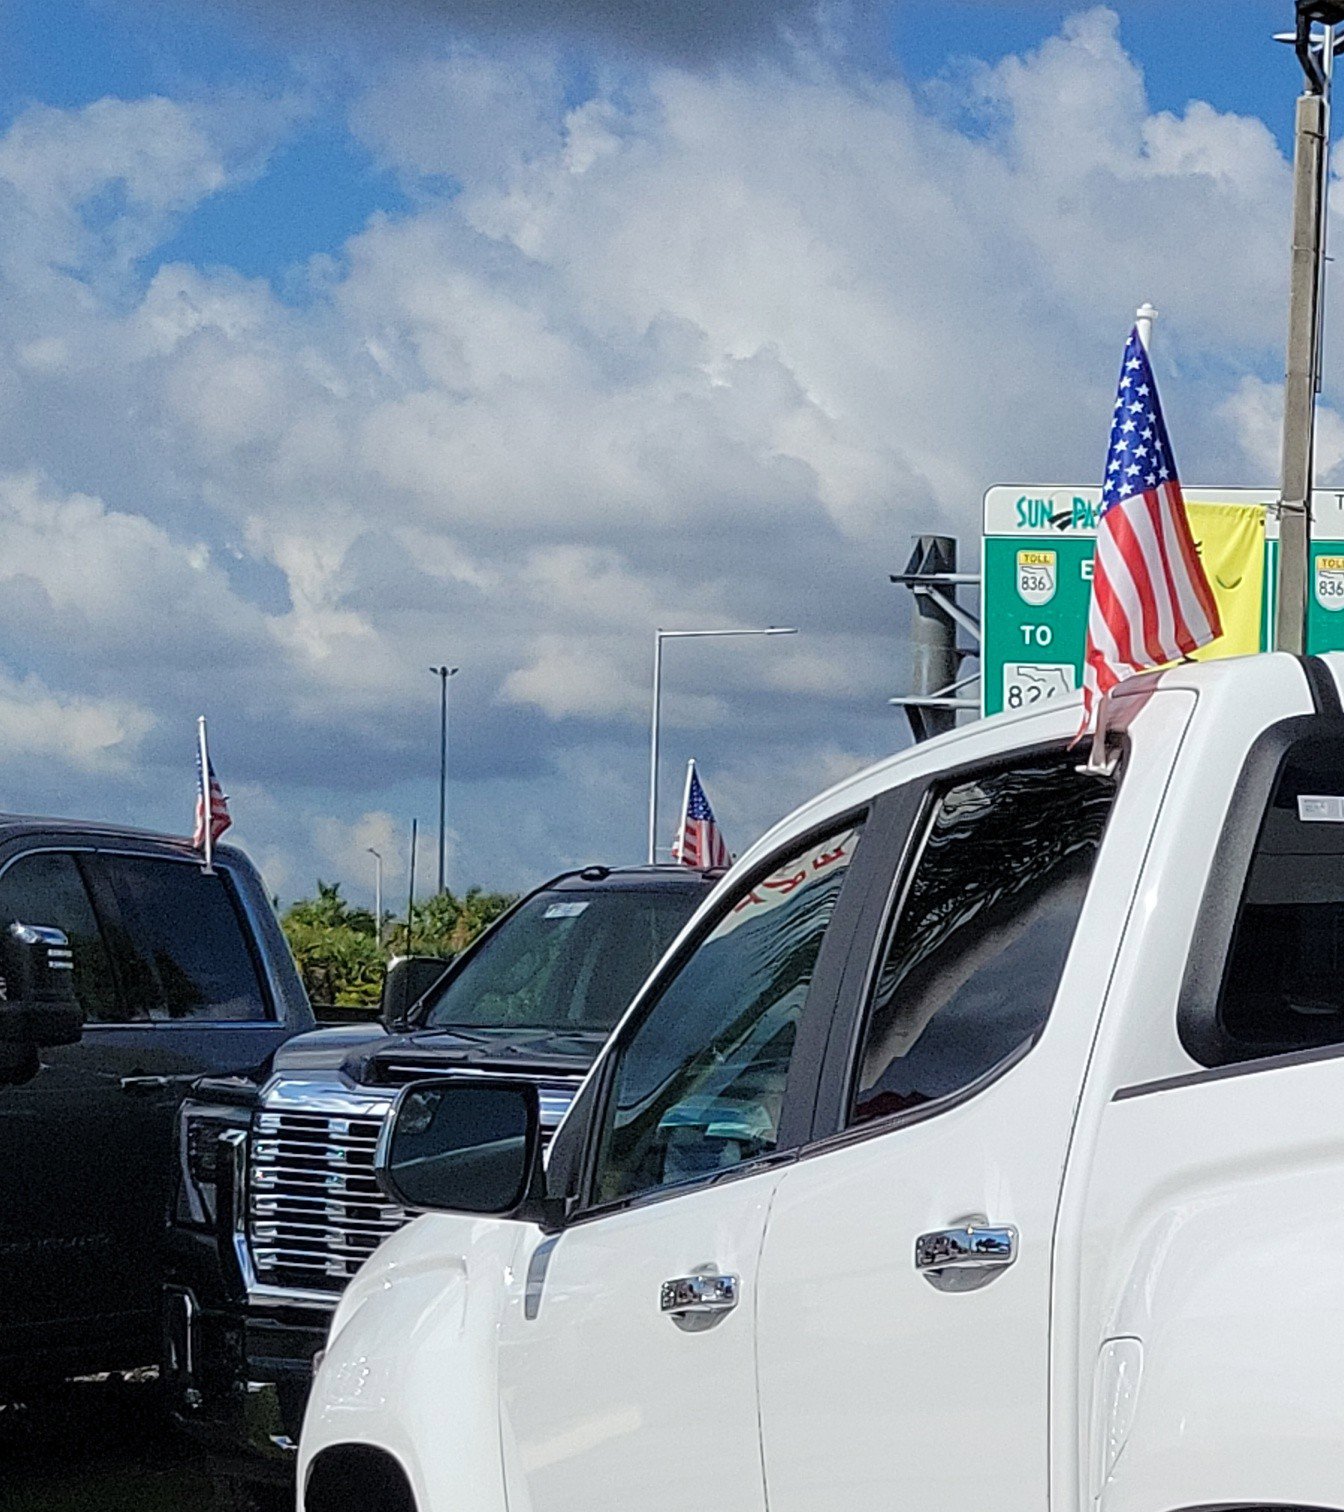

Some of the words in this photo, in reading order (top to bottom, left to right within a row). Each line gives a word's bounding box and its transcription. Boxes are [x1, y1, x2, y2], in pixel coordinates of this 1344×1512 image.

[1024, 553, 1050, 563] TOLL
[1021, 576, 1046, 591] 836
[1319, 580, 1344, 596] 836
[1020, 625, 1052, 646] TO
